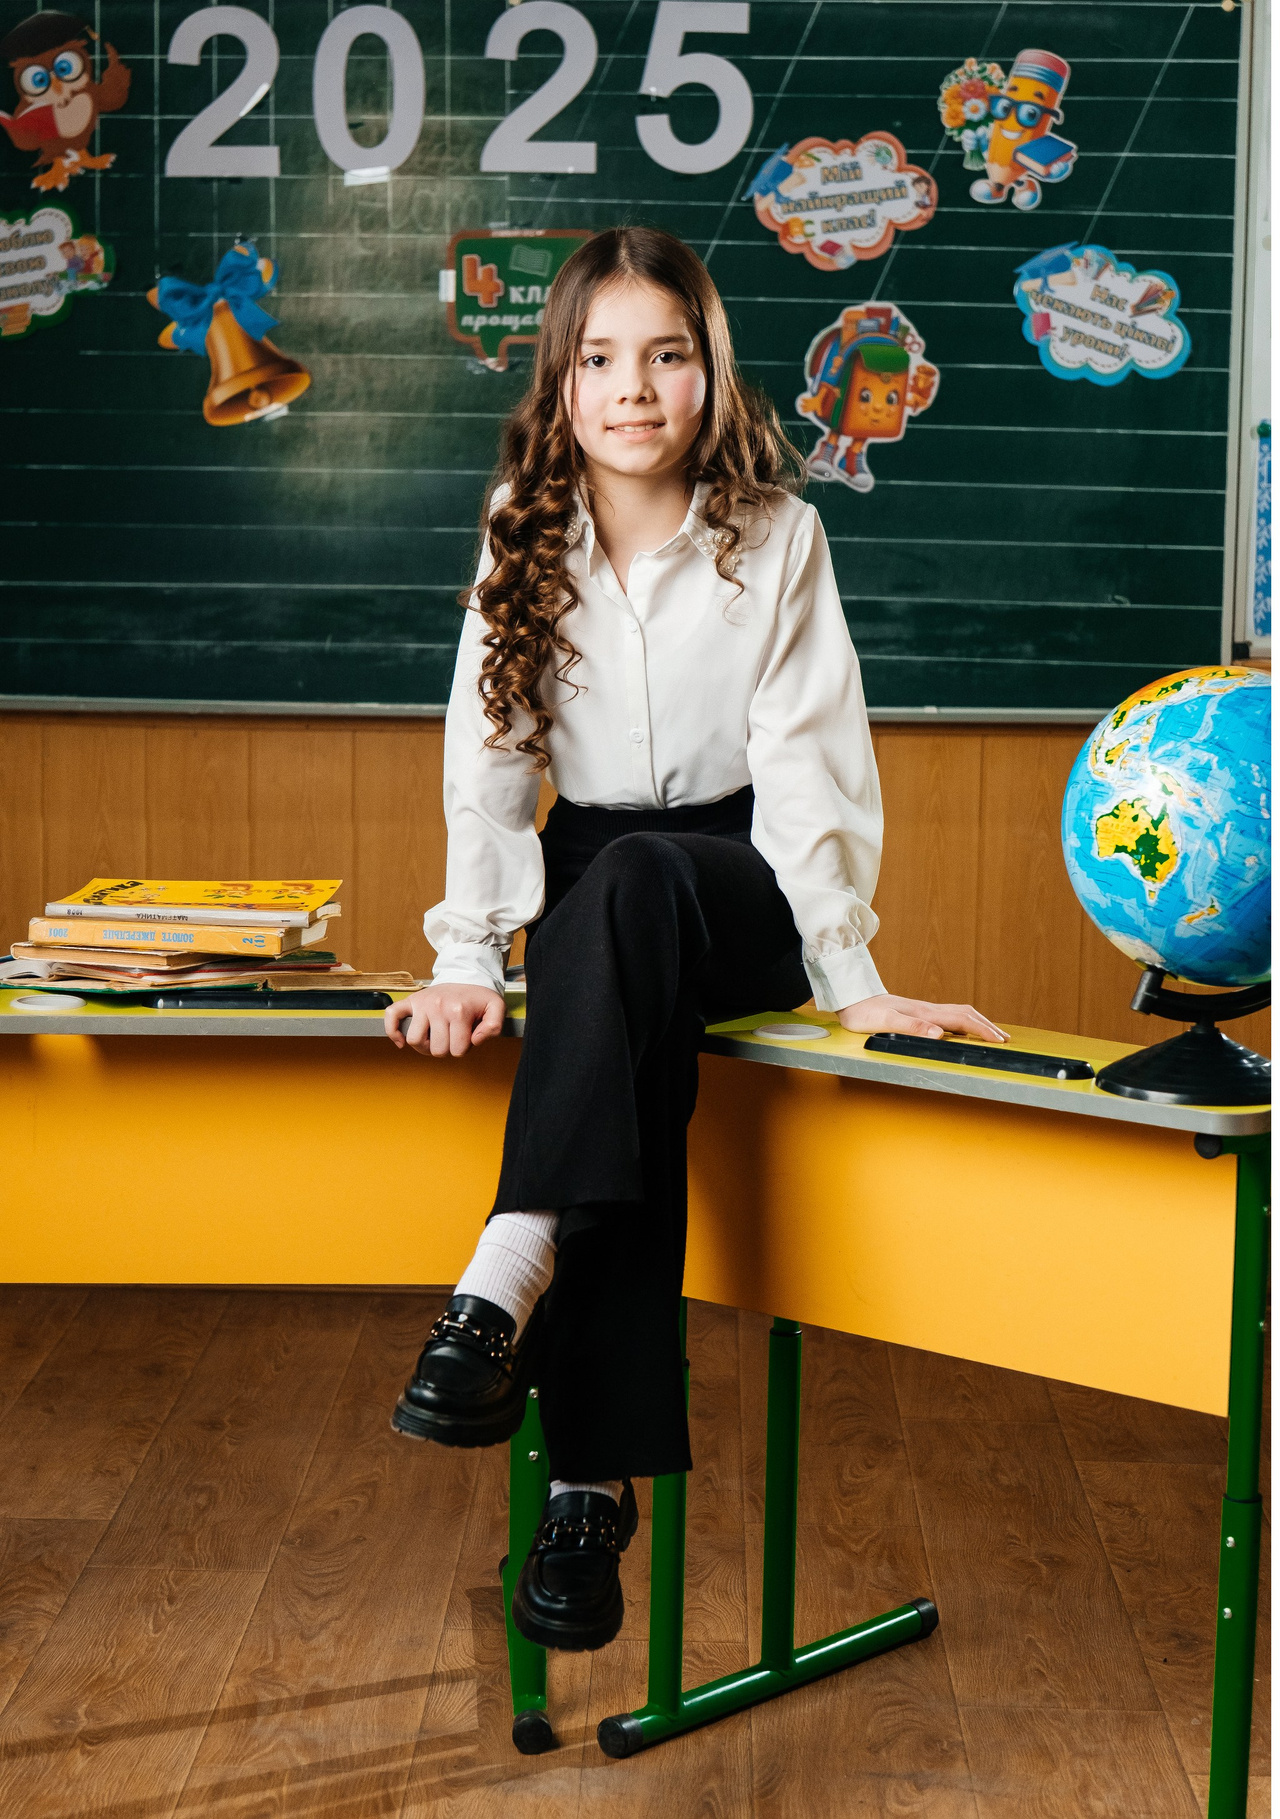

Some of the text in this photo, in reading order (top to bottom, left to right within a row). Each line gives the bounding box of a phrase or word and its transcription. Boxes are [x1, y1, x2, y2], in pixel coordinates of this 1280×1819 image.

[164, 0, 754, 178] 2025
[820, 160, 862, 185] Мій
[462, 253, 551, 308] 4 КЛ
[136, 913, 189, 922] МАТЕМАТИКА
[102, 928, 194, 944] ЗОЛОТЕ ДЖЕРЕЛЬЦЕ
